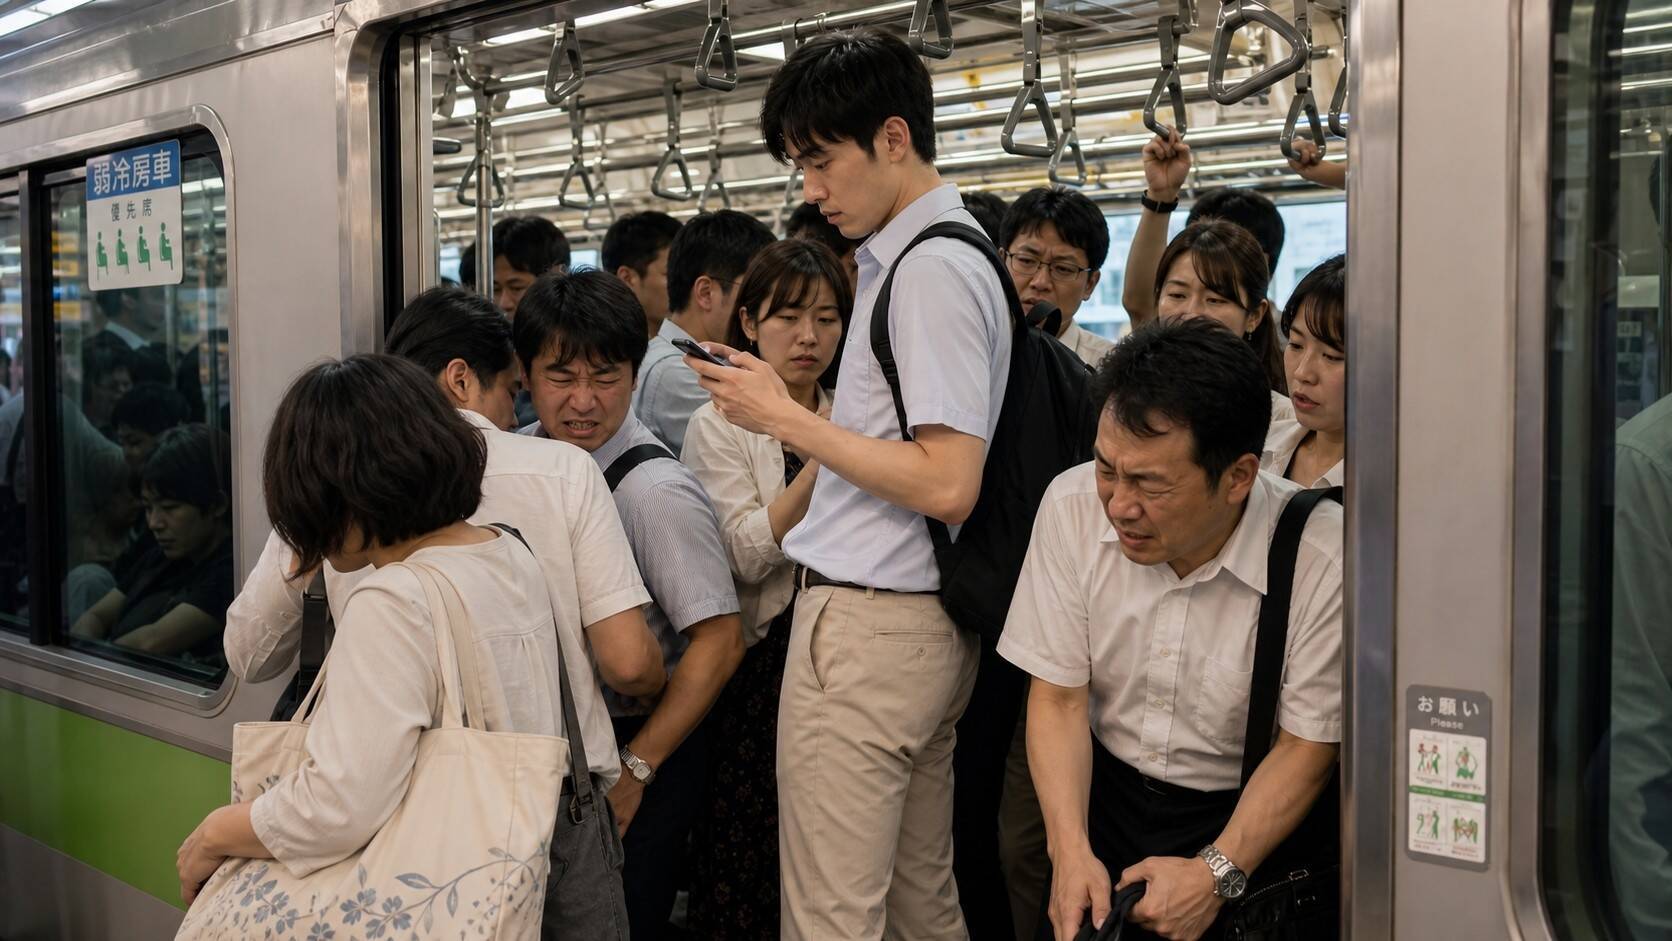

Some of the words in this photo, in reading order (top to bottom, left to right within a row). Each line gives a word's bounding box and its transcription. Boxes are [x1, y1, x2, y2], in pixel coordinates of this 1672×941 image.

[94, 149, 172, 195] 弱冷房車
[1418, 695, 1479, 718] お願い
[1430, 717, 1464, 730] Please
